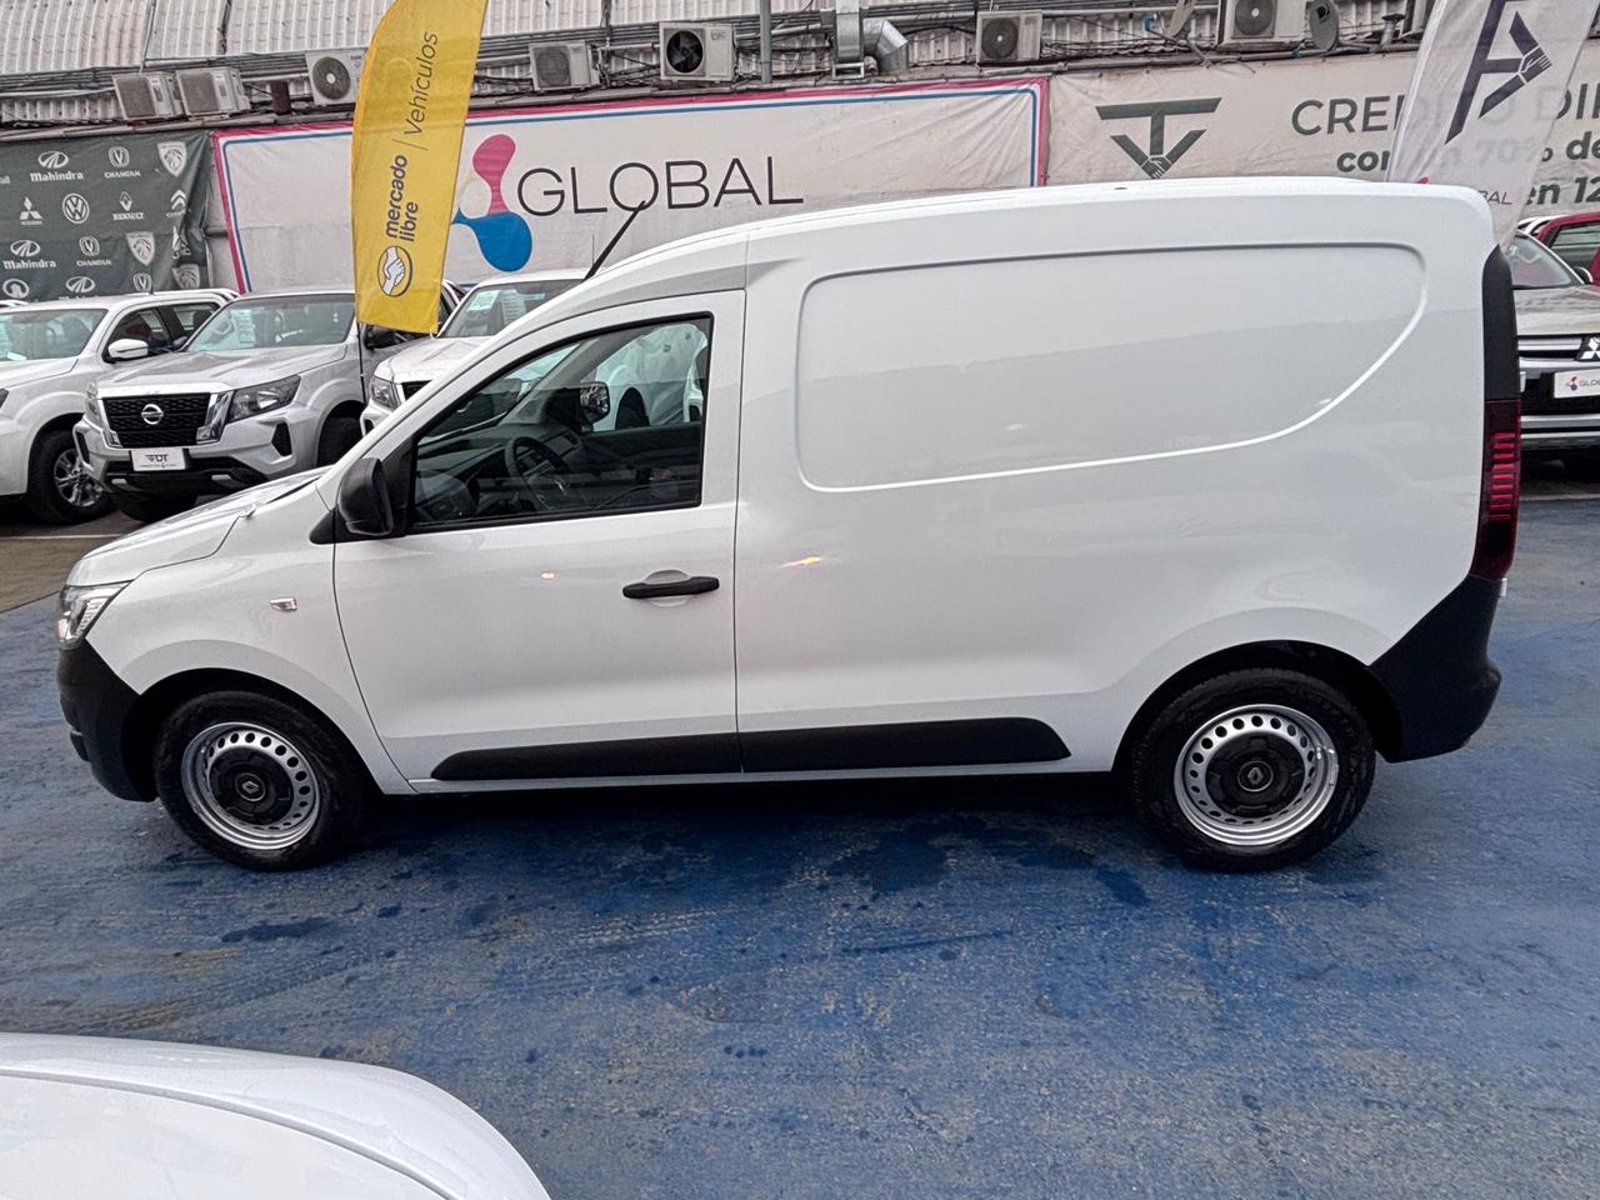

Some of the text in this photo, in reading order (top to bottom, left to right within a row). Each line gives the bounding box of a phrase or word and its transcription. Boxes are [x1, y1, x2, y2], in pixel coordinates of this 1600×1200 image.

[404, 31, 438, 135] Vehículos
[30, 170, 84, 182] Mahindra
[385, 155, 408, 239] mercado
[517, 156, 804, 216] GLOBAL
[399, 202, 419, 242] libre
[3, 259, 57, 269] Mahindra
